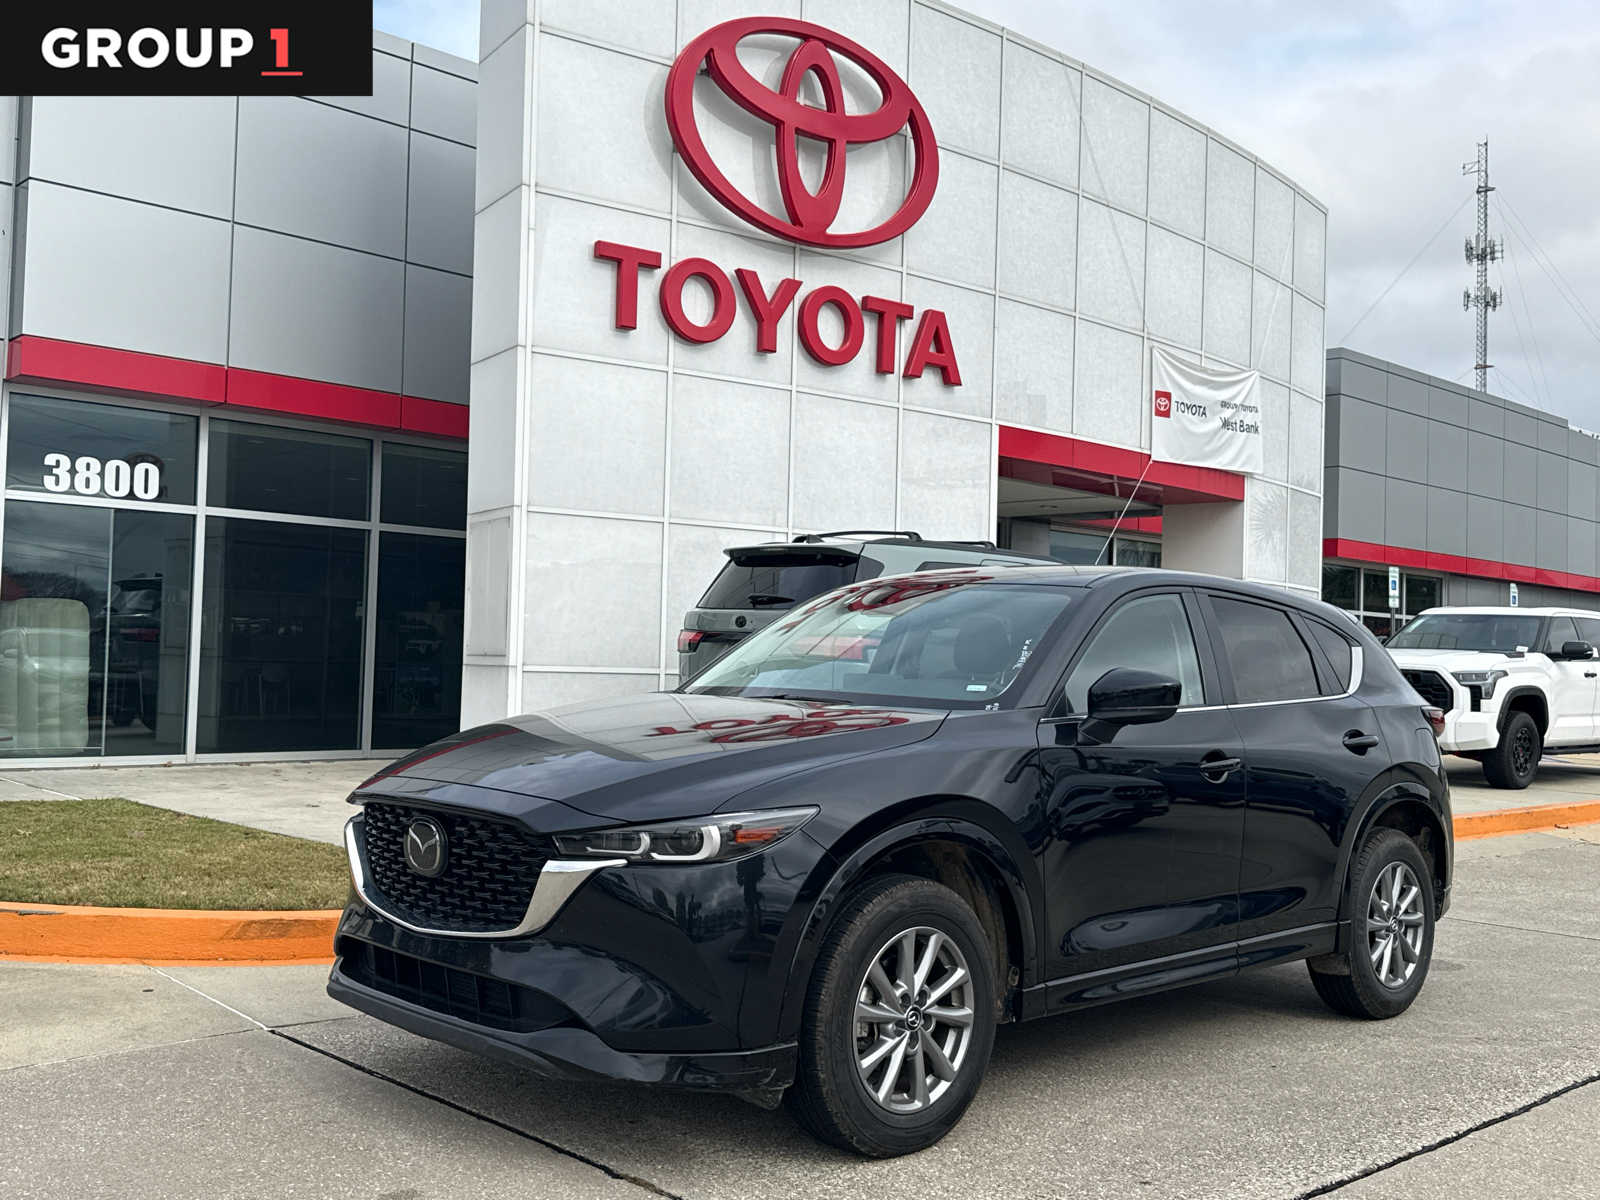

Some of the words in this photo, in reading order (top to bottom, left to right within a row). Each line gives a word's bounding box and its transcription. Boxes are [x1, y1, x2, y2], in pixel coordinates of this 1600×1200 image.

[594, 240, 962, 386] TOYOTA
[1174, 400, 1208, 418] TOYOTA
[1219, 416, 1237, 432] West
[1239, 419, 1260, 434] Bank
[43, 453, 160, 500] 3800
